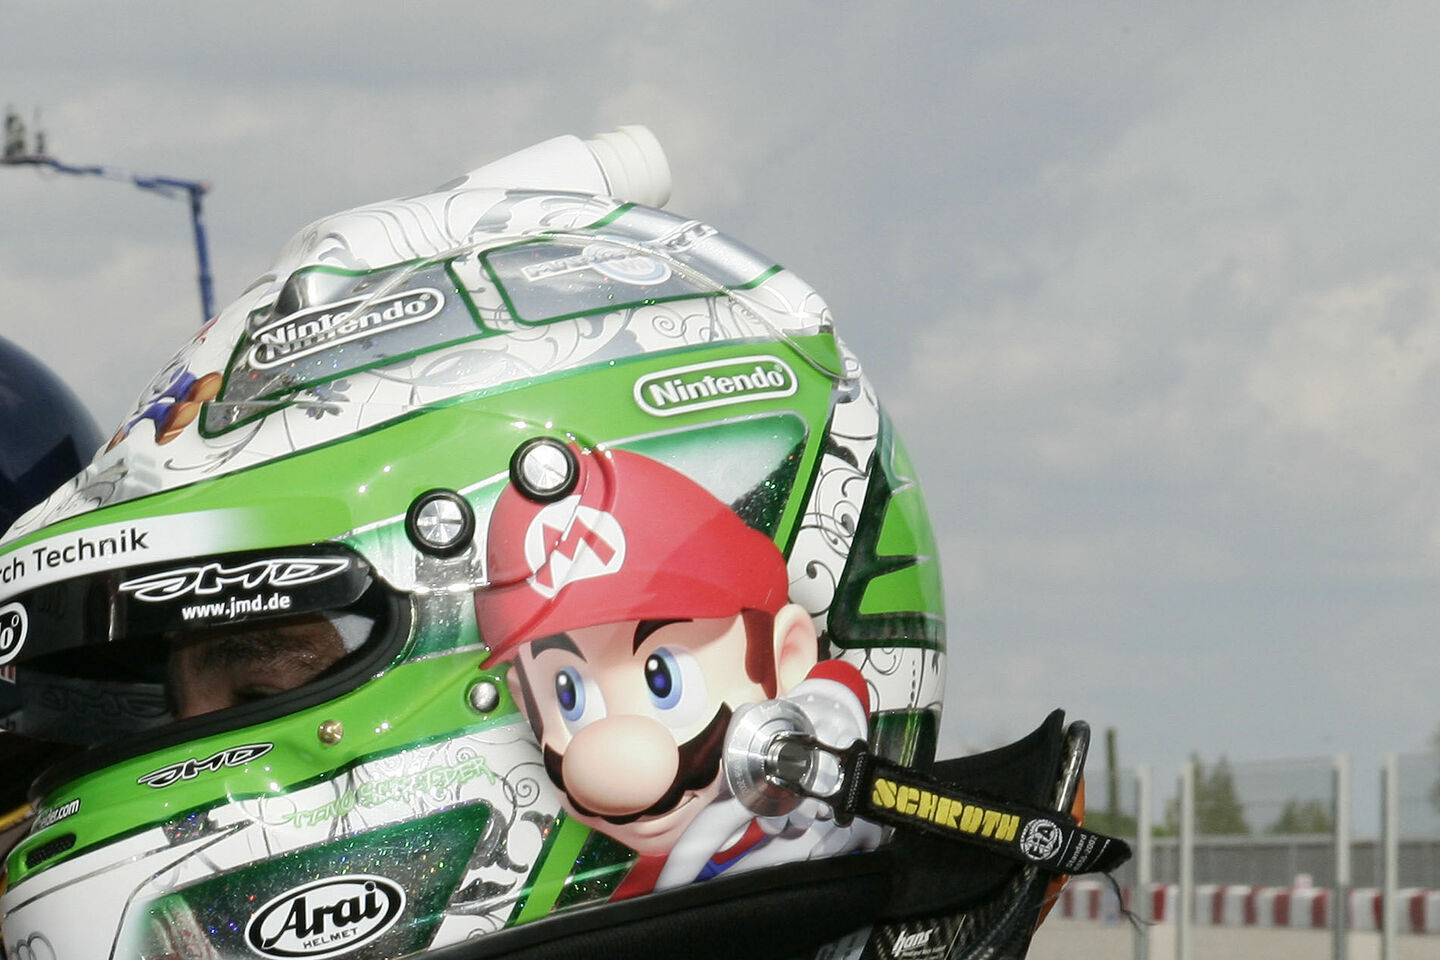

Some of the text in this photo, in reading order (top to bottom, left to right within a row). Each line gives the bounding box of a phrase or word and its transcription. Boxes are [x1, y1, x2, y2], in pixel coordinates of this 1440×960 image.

[648, 365, 785, 407] Nintendo
[32, 526, 150, 572] Technik
[535, 515, 616, 590] M
[181, 592, 291, 621] www.jmd.de
[871, 777, 1021, 842] SCHROTH
[262, 880, 383, 949] Arai
[303, 926, 359, 950] HELMET
[891, 928, 934, 958] hans
